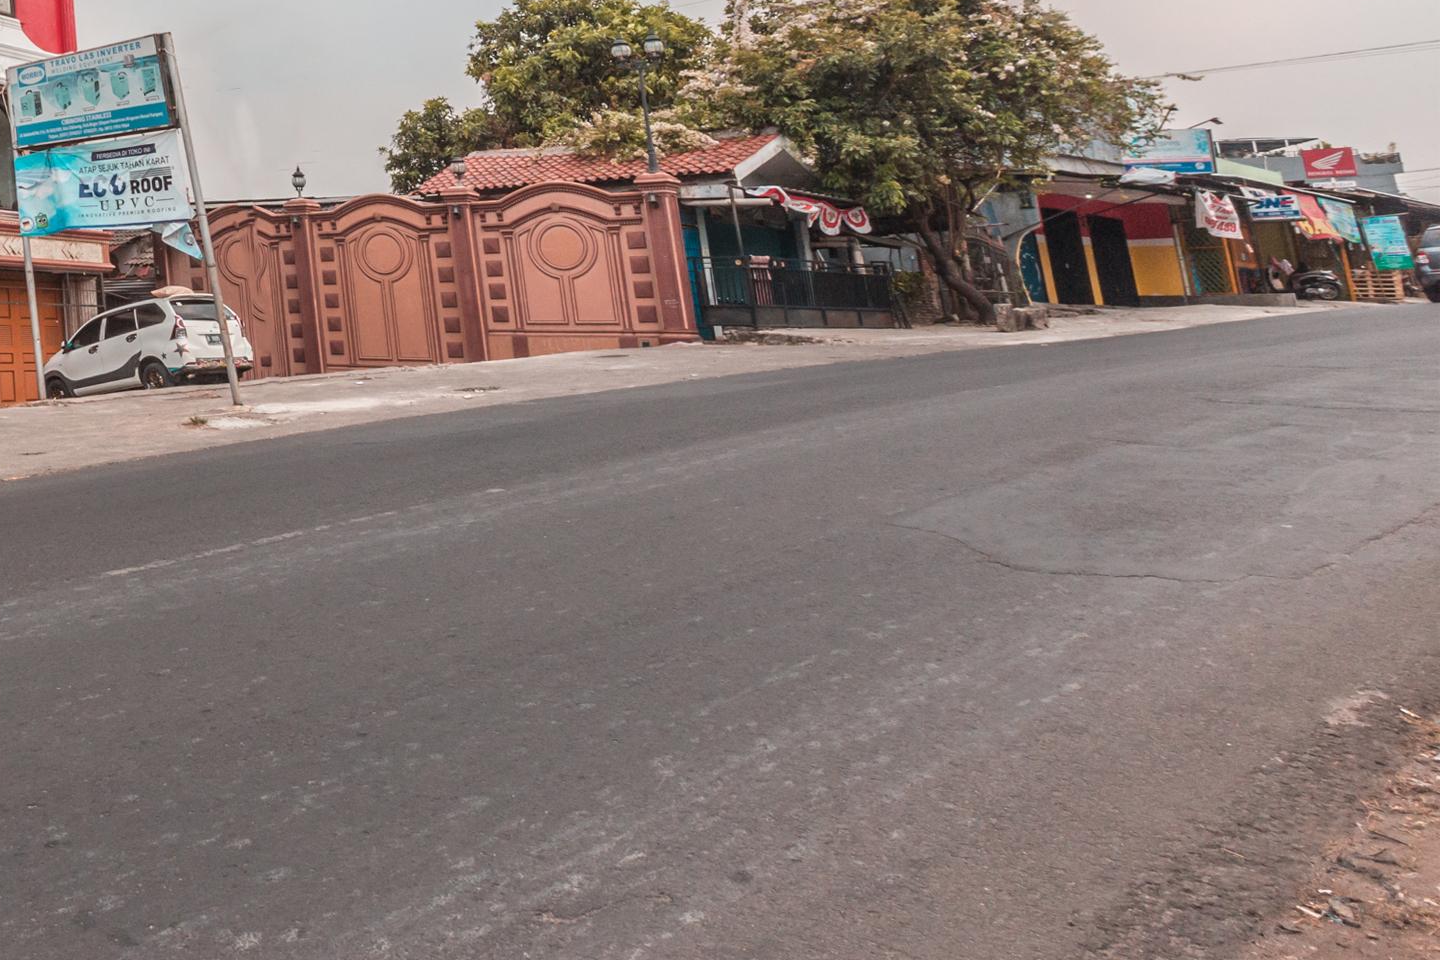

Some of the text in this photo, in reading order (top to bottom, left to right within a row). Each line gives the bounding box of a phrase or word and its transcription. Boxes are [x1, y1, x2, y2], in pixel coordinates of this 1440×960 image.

[51, 41, 141, 68] TRAVO LAS INVERTER
[79, 155, 170, 174] ATAP SEJUK TAHAN KARAT
[130, 175, 173, 194] ROOF
